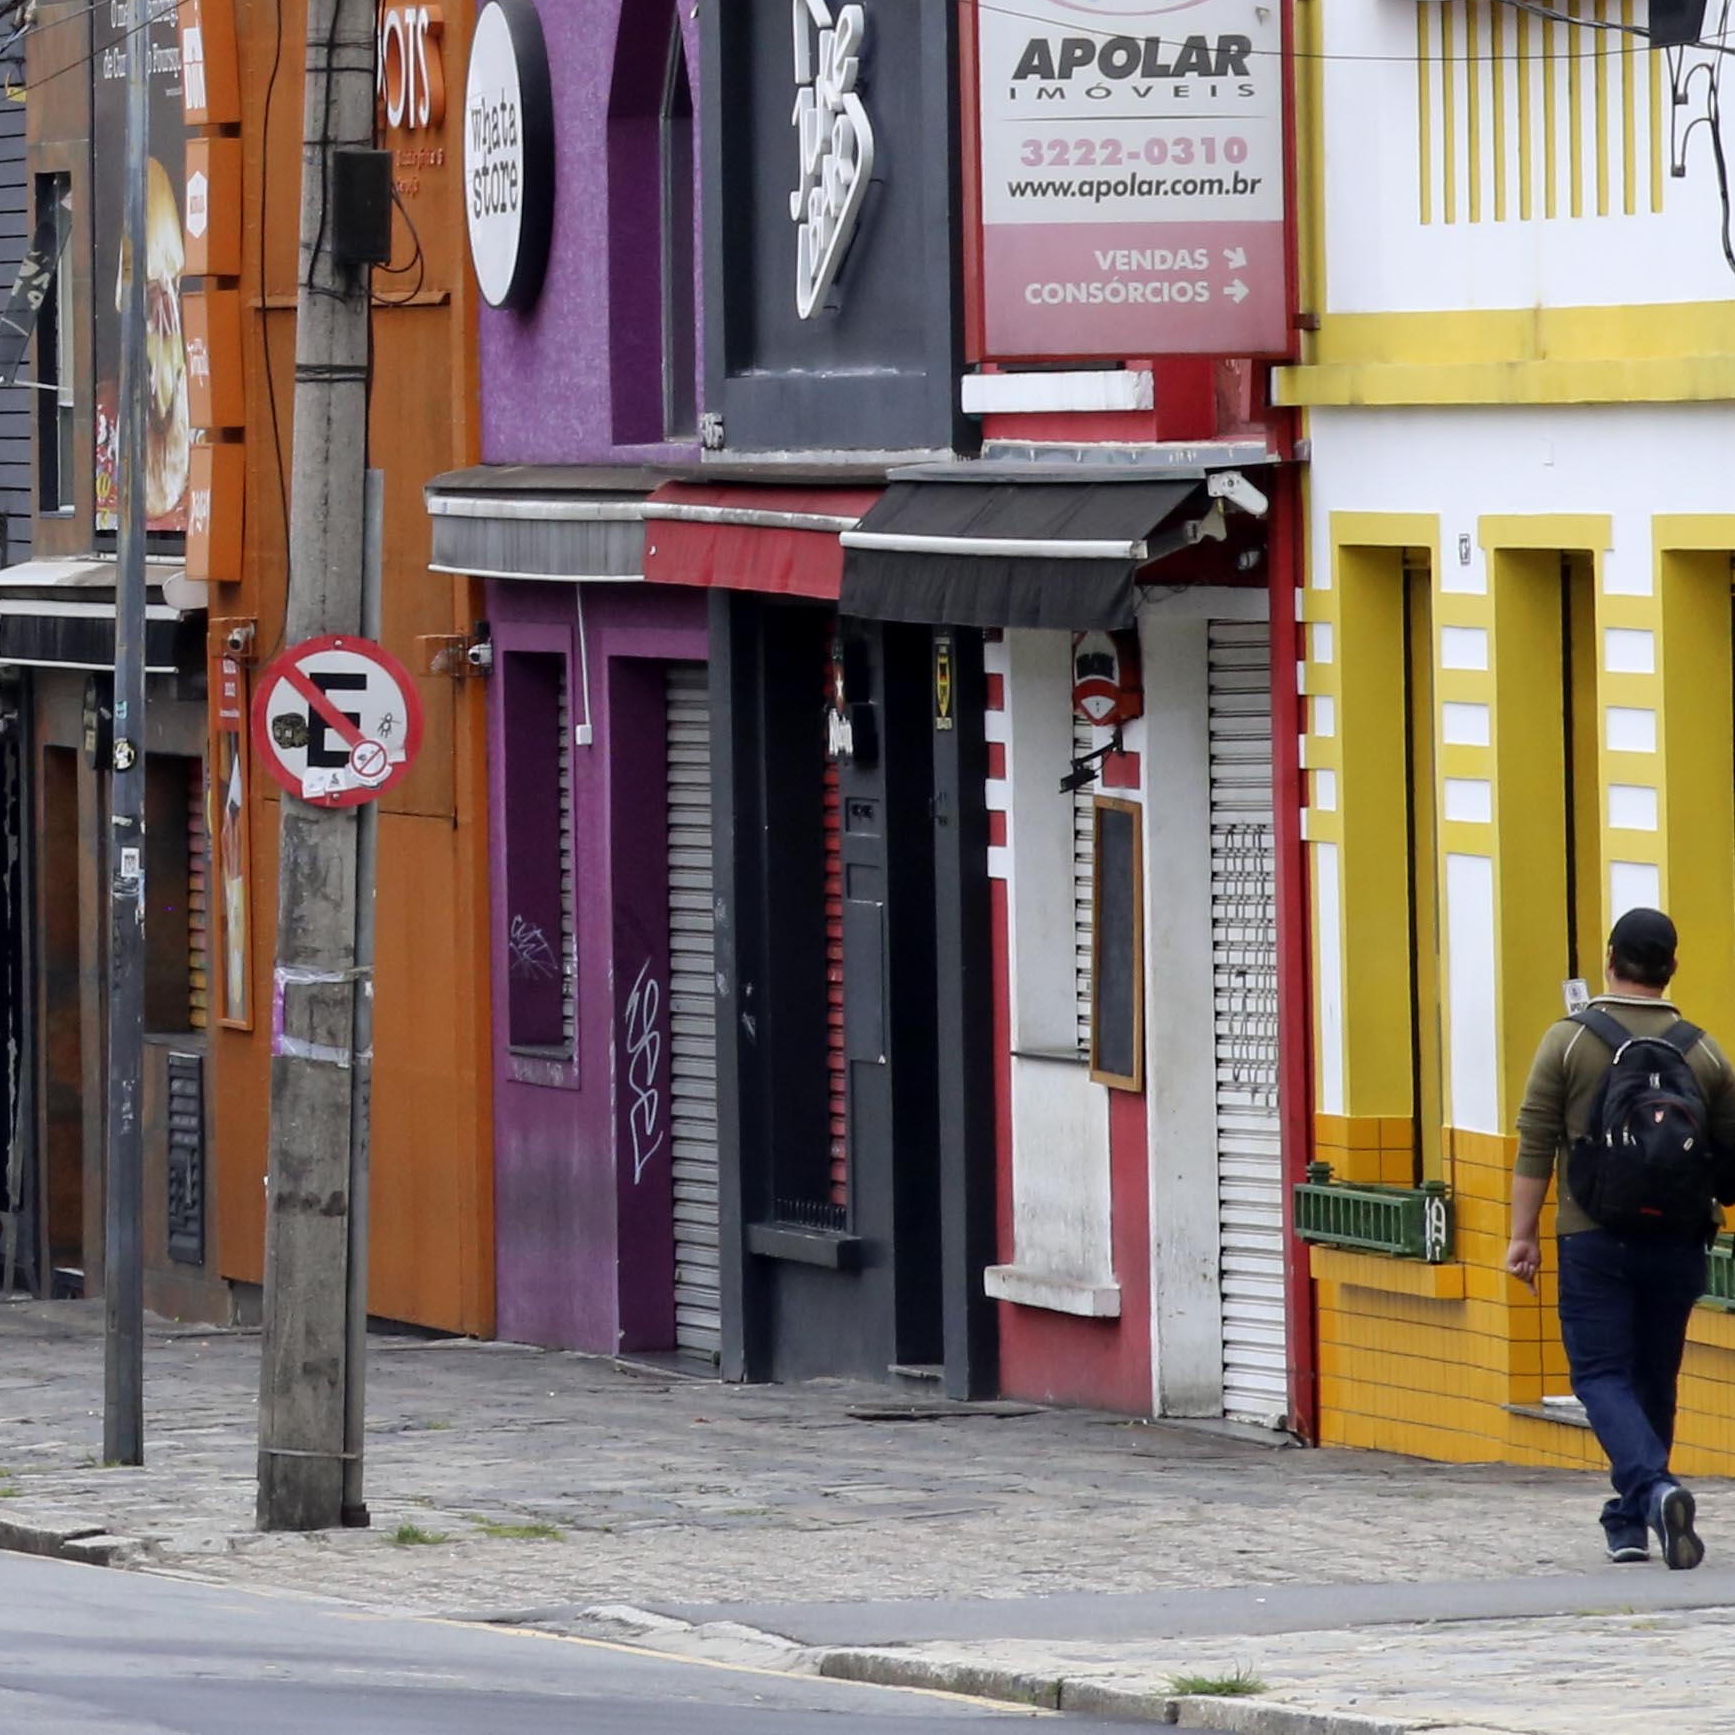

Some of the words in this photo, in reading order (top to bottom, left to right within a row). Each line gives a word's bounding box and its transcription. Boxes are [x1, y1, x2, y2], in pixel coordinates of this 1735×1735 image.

[1011, 34, 1253, 81] APOLAR
[1009, 82, 1255, 101] IMÓVEIS
[1020, 136, 1248, 167] 3222-0310
[473, 152, 519, 219] store
[1008, 171, 1262, 203] www.apolar.com.br
[1094, 248, 1209, 271] VENDAS
[1024, 276, 1210, 304] CONSÓRCIOS
